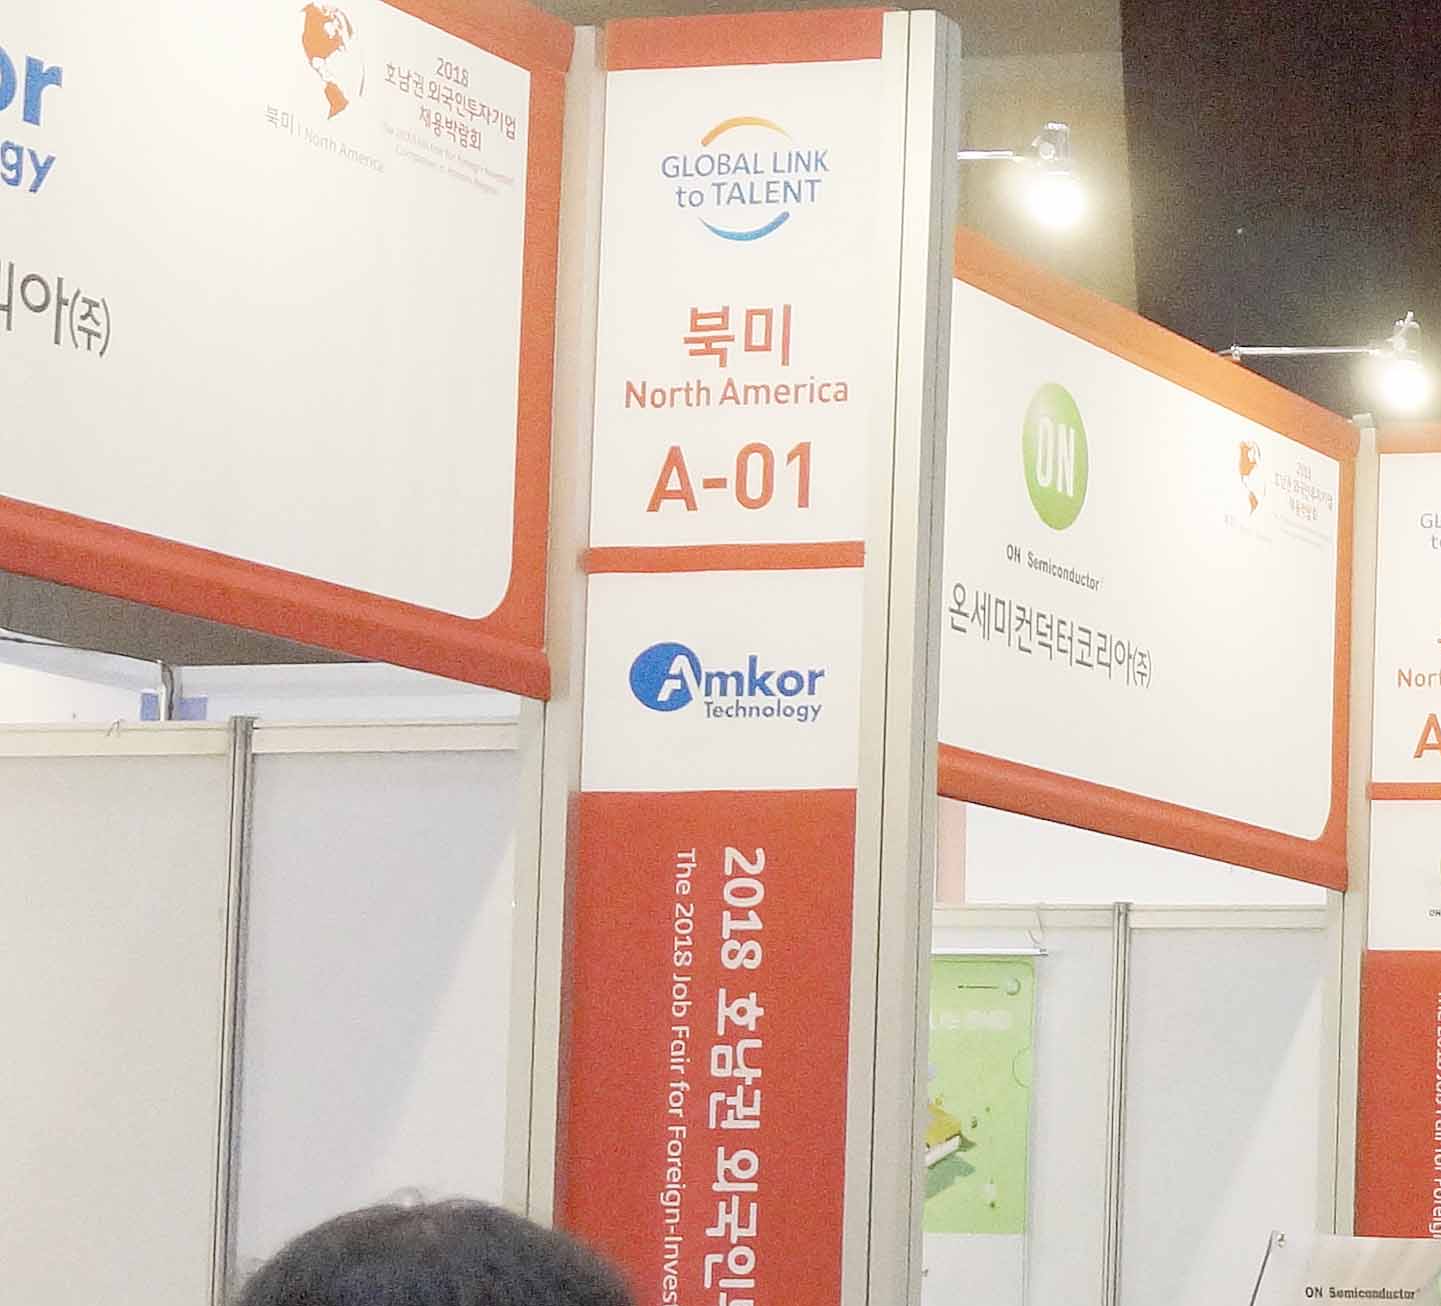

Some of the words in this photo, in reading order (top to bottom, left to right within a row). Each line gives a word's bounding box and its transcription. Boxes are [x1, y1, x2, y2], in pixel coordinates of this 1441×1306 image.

[435, 57, 469, 88] 2018
[661, 151, 765, 180] GLOBAL
[771, 148, 829, 175] LINK
[676, 185, 704, 209] to
[712, 178, 822, 205] TALENT
[683, 304, 792, 368] 북미
[624, 378, 711, 409] North
[719, 376, 849, 405] America
[646, 441, 811, 513] A-01
[1035, 417, 1075, 497] ON
[1006, 544, 1021, 564] ON
[1027, 551, 1100, 592] Semiconductor
[949, 582, 1152, 688] 온세미컨덕터코리아(주)
[629, 640, 825, 712] Amkor
[704, 698, 822, 722] Technology
[675, 848, 696, 896] The
[721, 846, 766, 970] 2018
[673, 904, 694, 967] 2018
[671, 973, 692, 1018] Job
[670, 1025, 691, 1074] Fair
[708, 988, 765, 1130] 호남권
[668, 1081, 691, 1118] for
[1305, 1287, 1323, 1299] ON
[1329, 1287, 1416, 1300] Semiconductor
